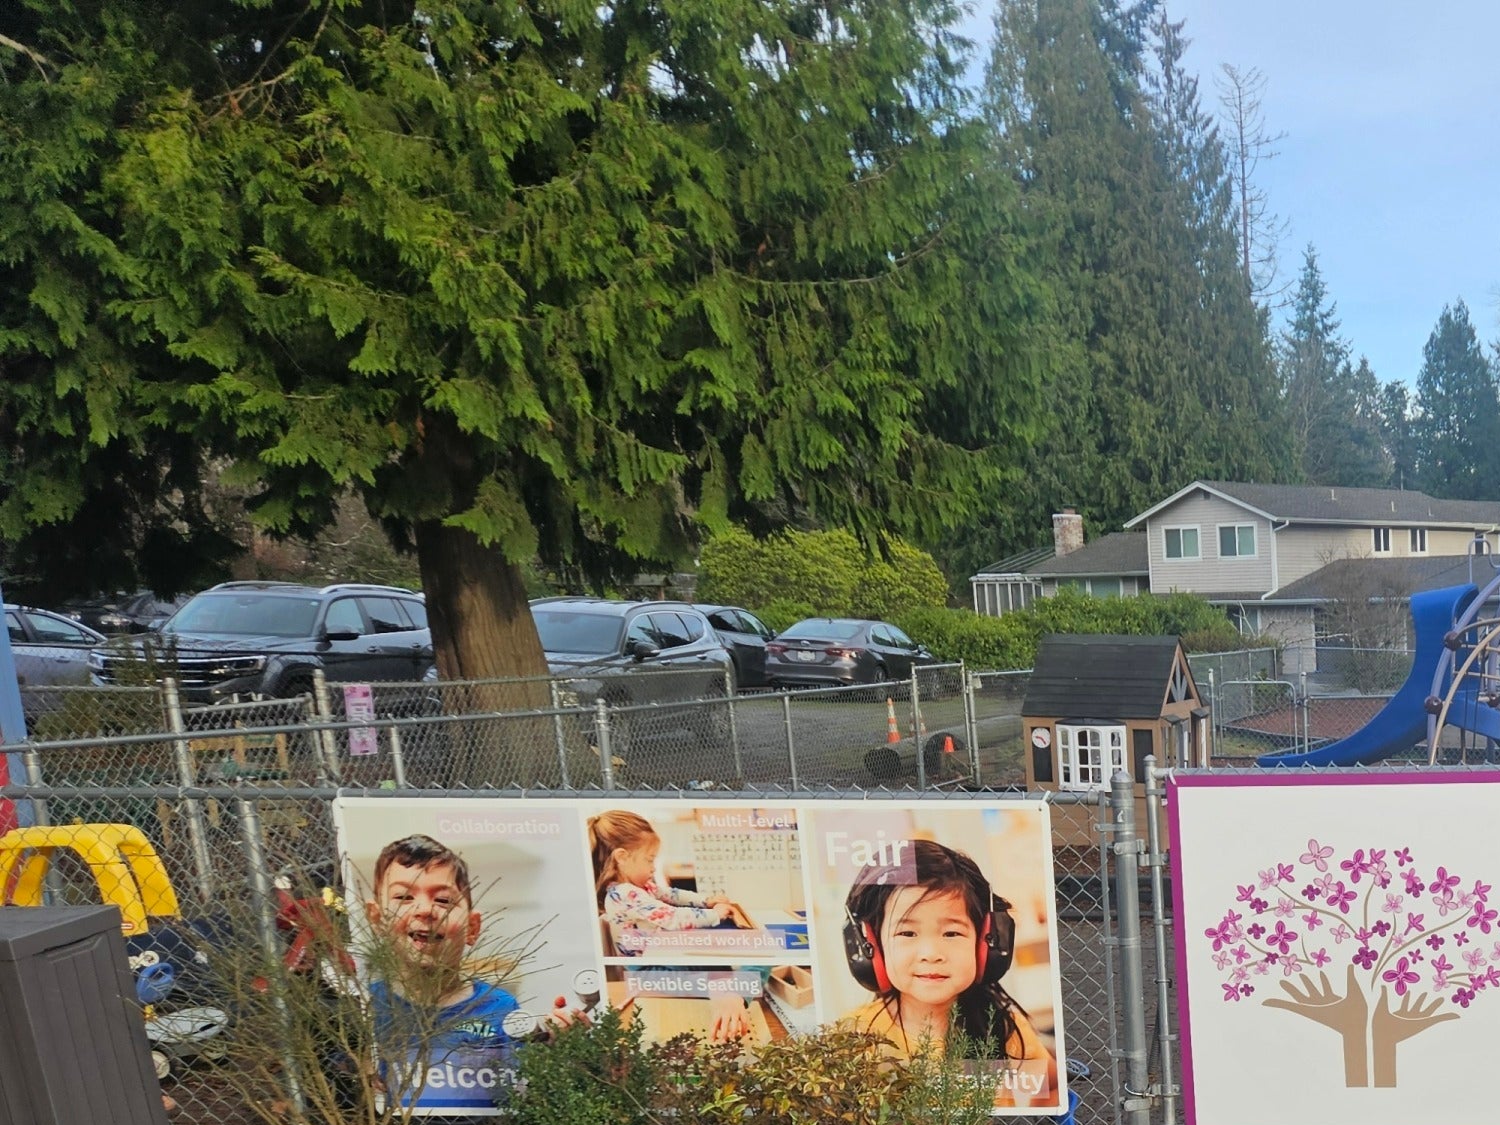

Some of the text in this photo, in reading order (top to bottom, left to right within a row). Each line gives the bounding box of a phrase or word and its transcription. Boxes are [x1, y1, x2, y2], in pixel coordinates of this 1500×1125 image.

[439, 819, 560, 834] Collaboration
[702, 814, 789, 828] Multi-Level
[825, 829, 909, 867] Fair
[622, 934, 784, 949] Personalized work plan
[627, 978, 761, 995] Flexible Seating
